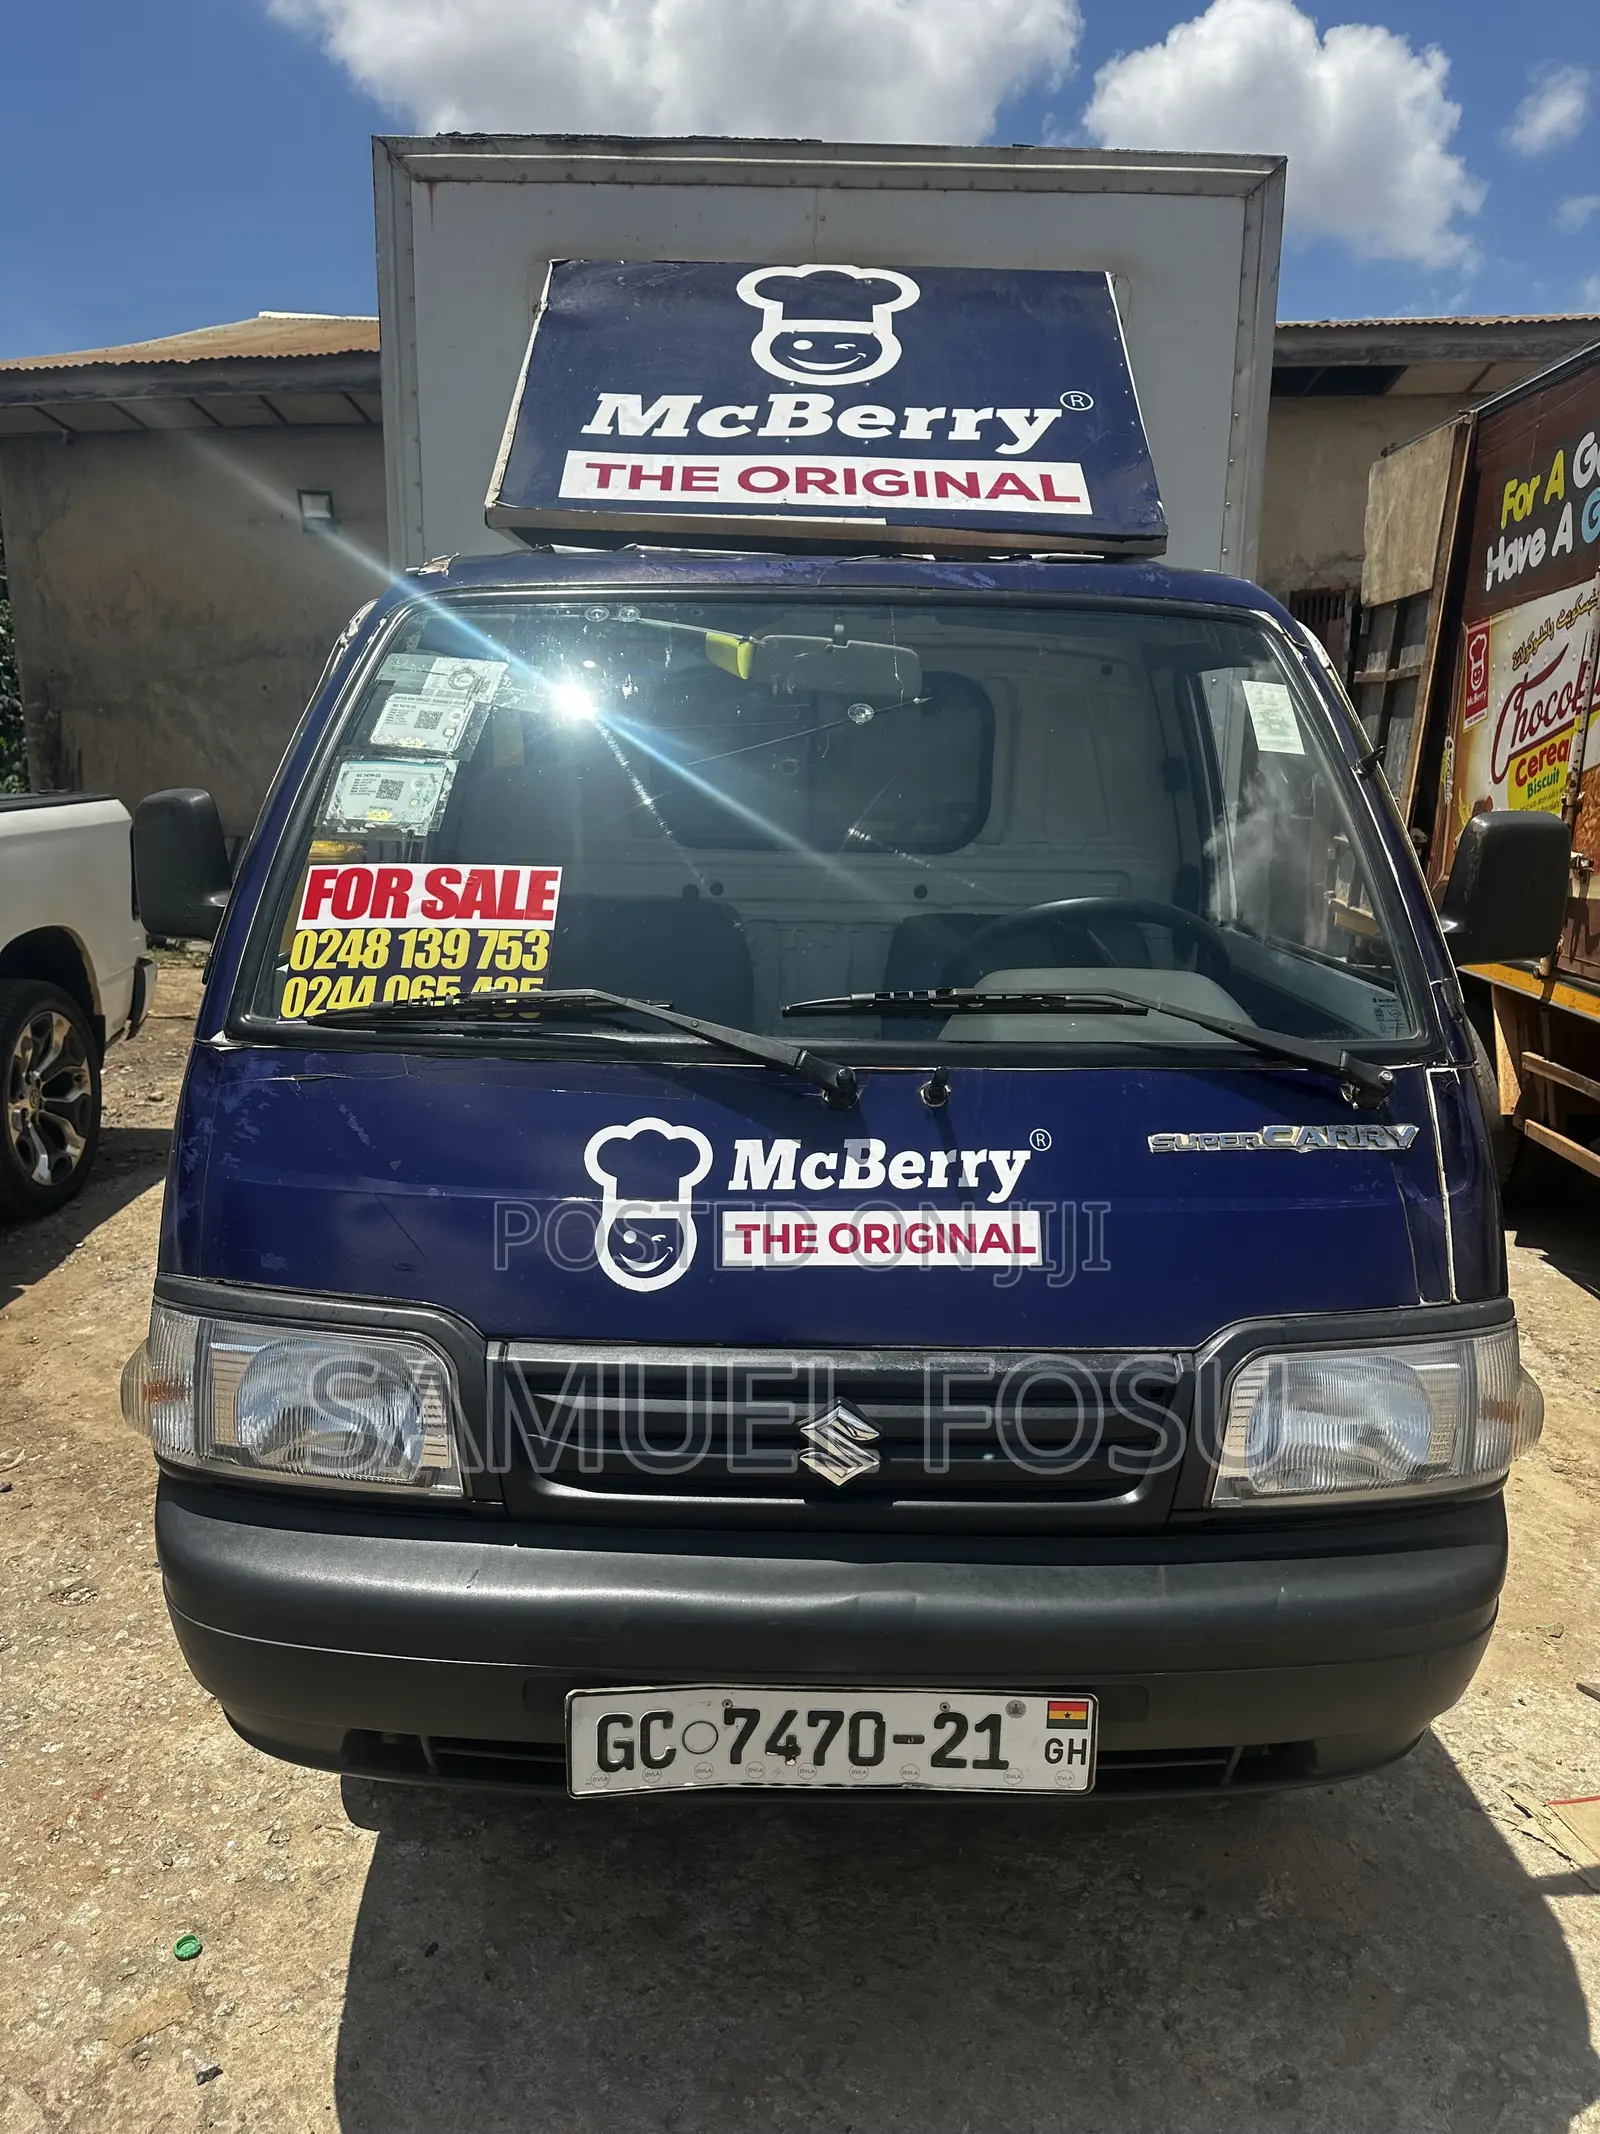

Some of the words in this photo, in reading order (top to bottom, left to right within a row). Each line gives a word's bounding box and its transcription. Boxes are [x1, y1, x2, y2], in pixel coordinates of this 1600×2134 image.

[585, 461, 720, 494] THE
[737, 465, 1081, 503] ORIGINAL
[1501, 474, 1541, 530] For
[1544, 449, 1565, 505] A
[1572, 431, 1600, 489] G
[1485, 527, 1547, 592] Have
[1551, 501, 1573, 557] A
[1515, 738, 1570, 788] Cerea
[1527, 766, 1560, 799] Biscuit
[301, 867, 414, 921] FOR
[420, 867, 560, 922] SALE
[289, 928, 392, 971] 0248
[397, 927, 471, 969] 139
[476, 929, 551, 972] 753
[280, 975, 377, 1019] 0244
[735, 1223, 818, 1255] THE
[828, 1223, 1037, 1255] ORIGINAL
[595, 1711, 677, 1772] GC
[722, 1708, 1010, 1771] 7470-21
[1044, 1737, 1087, 1766] GH
